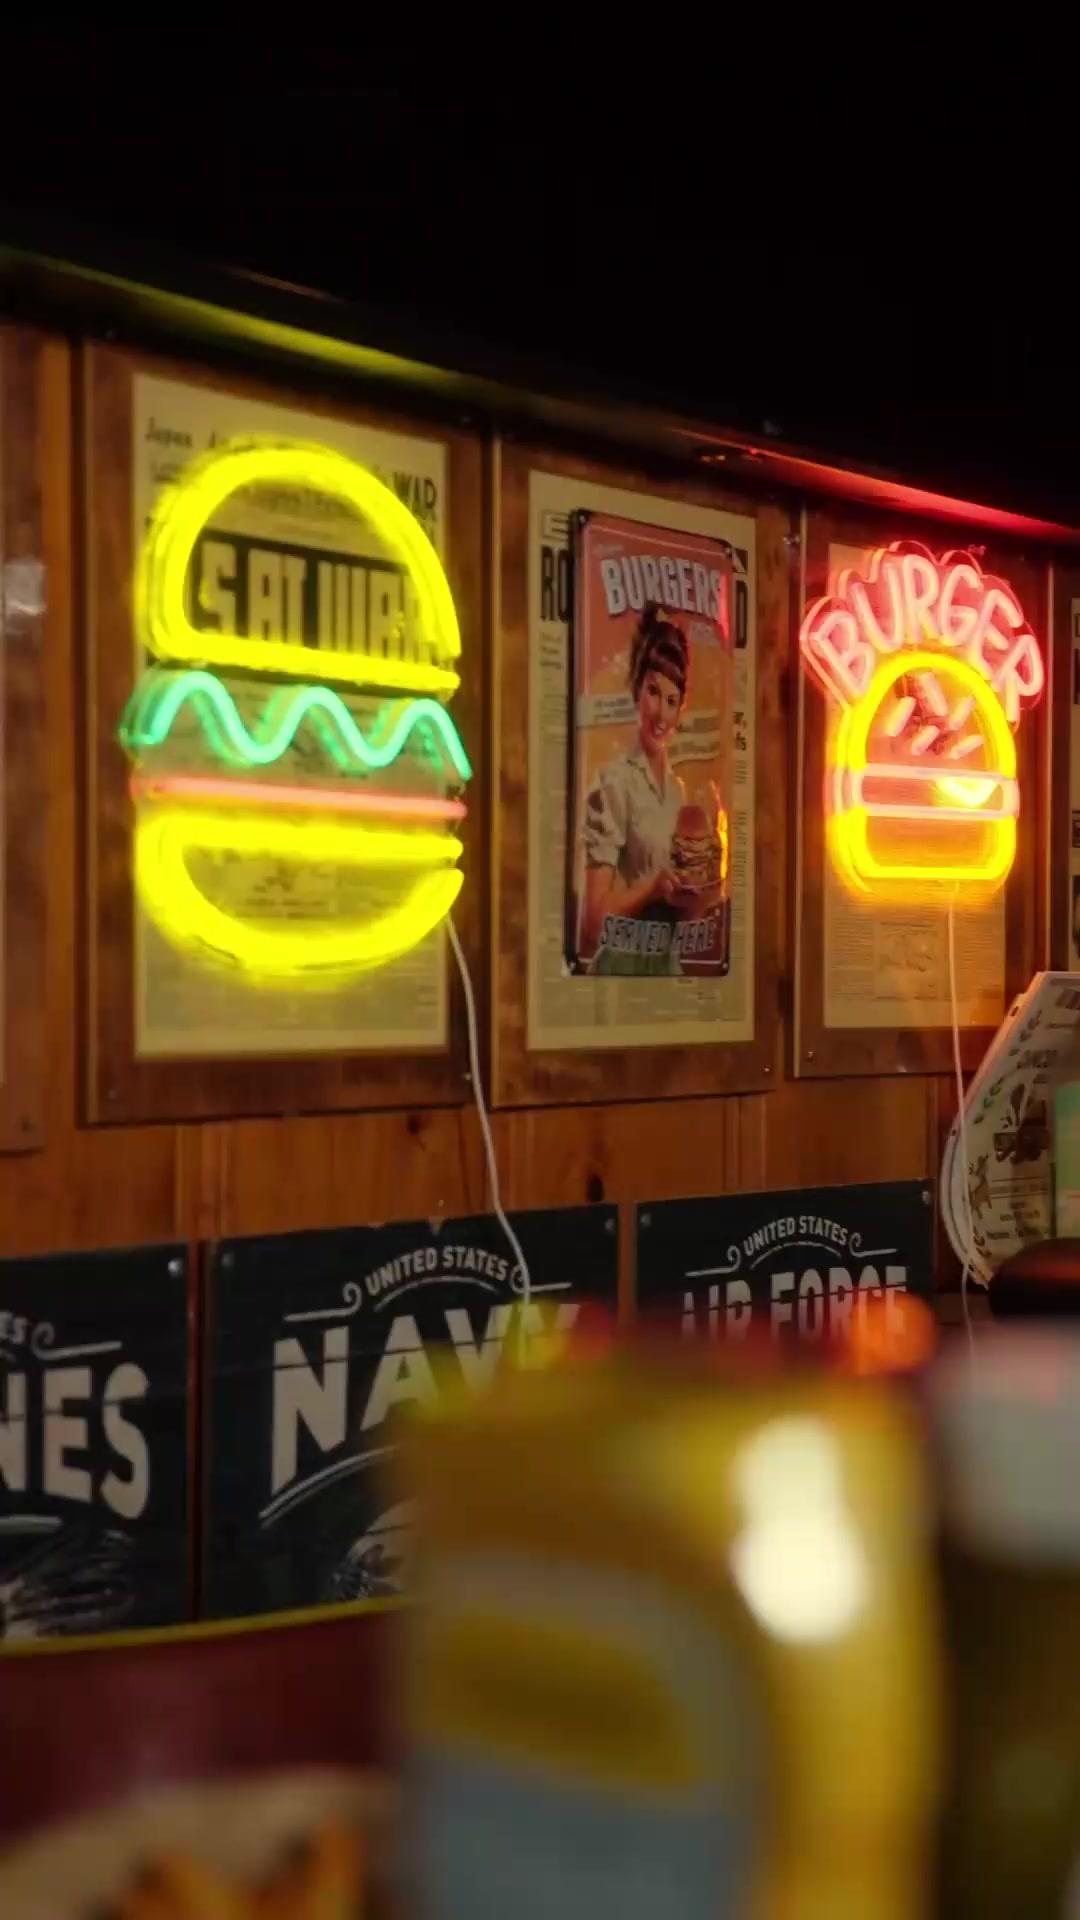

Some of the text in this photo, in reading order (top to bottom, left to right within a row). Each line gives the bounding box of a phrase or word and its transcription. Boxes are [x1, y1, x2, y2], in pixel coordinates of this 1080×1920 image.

[393, 472, 438, 522] WAR
[601, 554, 722, 620] BURGERS
[807, 554, 1045, 722] BURGER
[600, 912, 718, 956] SERVED HERE
[744, 1215, 849, 1256] UNITED STATES
[365, 1245, 508, 1297] UNITED STATES
[681, 1265, 908, 1343] AIR FORCE
